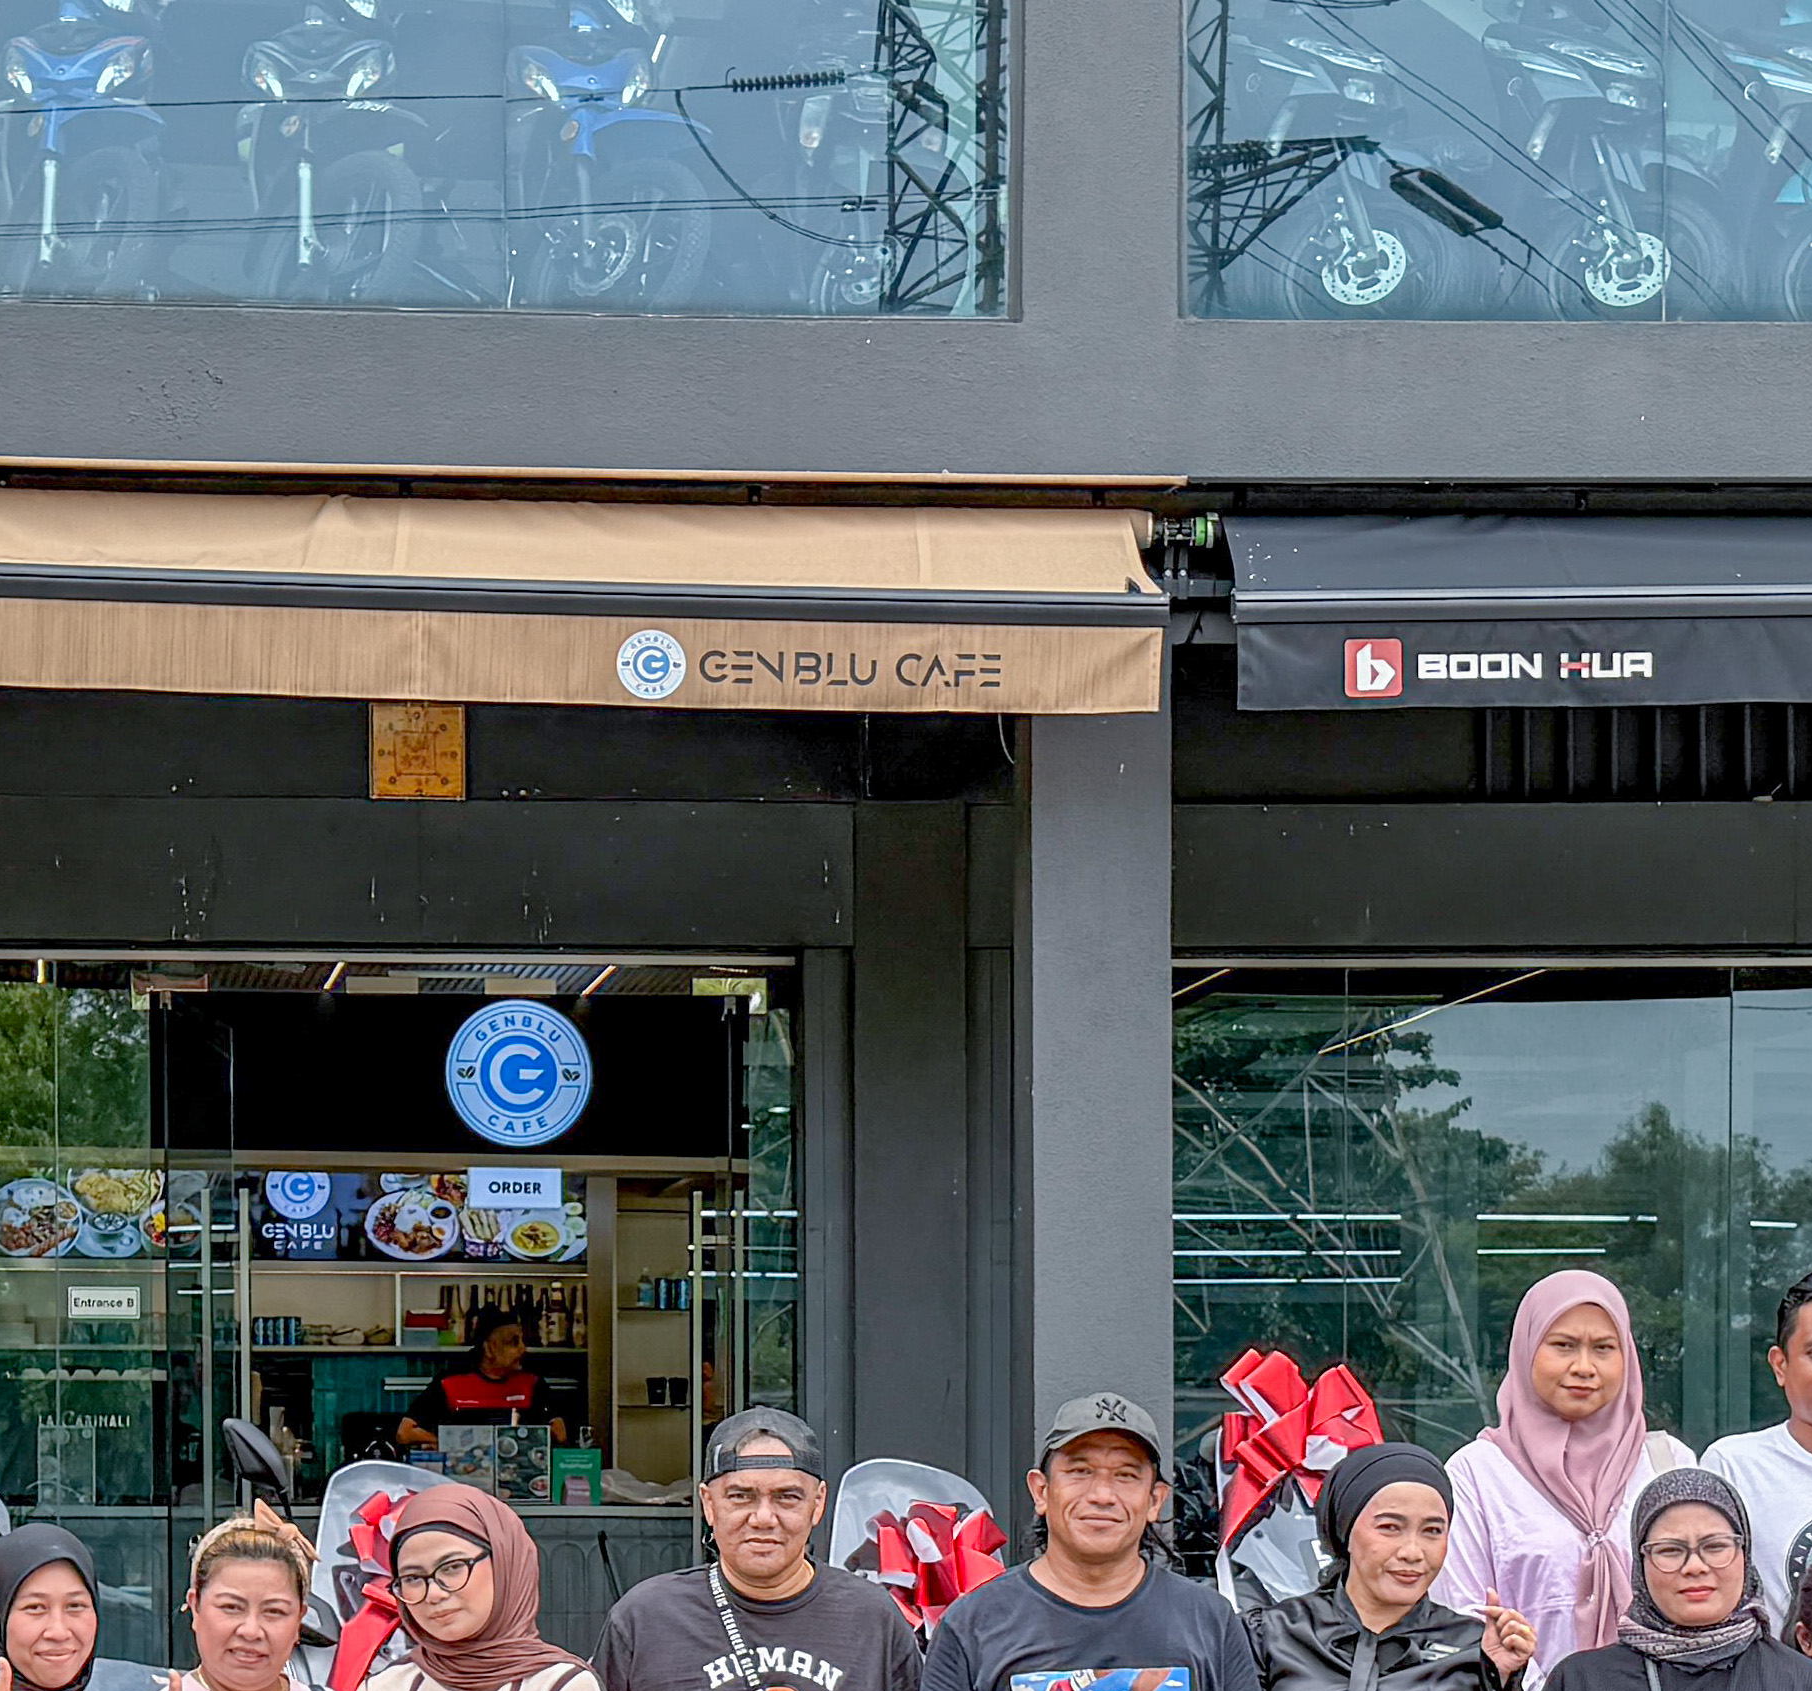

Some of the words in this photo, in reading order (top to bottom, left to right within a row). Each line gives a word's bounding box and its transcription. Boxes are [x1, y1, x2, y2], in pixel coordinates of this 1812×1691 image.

[699, 650, 877, 685] GENBLU
[895, 653, 1001, 687] CAFE
[1417, 653, 1543, 679] BOON
[1560, 652, 1653, 679] HUA
[475, 1015, 562, 1043] GENBLU
[487, 1114, 549, 1133] CAFE
[488, 1181, 542, 1195] ORDER
[262, 1222, 335, 1239] GENBLU
[274, 1241, 323, 1250] CAFE
[73, 1297, 123, 1308] Entrance
[127, 1298, 135, 1308] B
